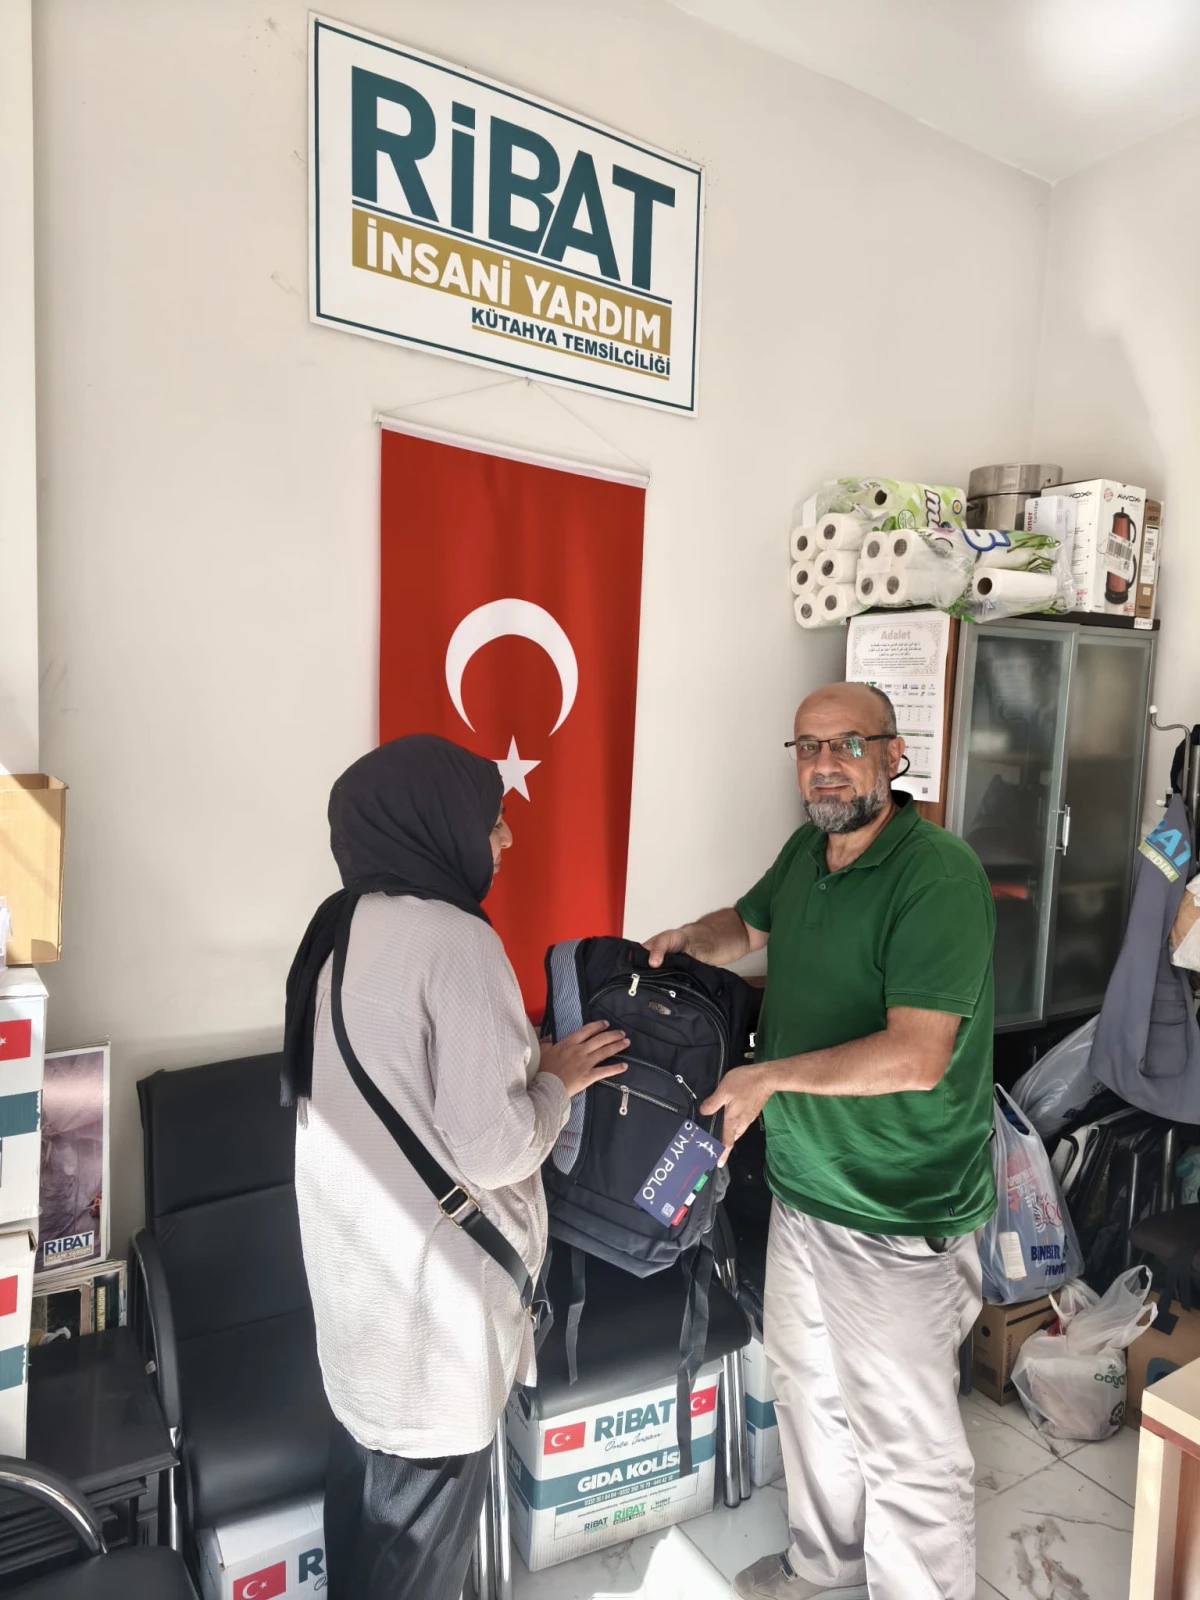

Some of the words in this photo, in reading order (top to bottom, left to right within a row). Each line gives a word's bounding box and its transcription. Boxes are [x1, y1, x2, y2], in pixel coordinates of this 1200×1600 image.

[366, 216, 511, 307] İNSANİ
[524, 274, 661, 349] YARDIM
[471, 307, 558, 346] KÜTAHYA
[1117, 493, 1141, 503] AWOX
[881, 629, 911, 640] Adalet
[670, 1134, 690, 1160] MY
[642, 1157, 675, 1200] POLO
[604, 1438, 629, 1452] Önce
[577, 1469, 624, 1492] GIDA
